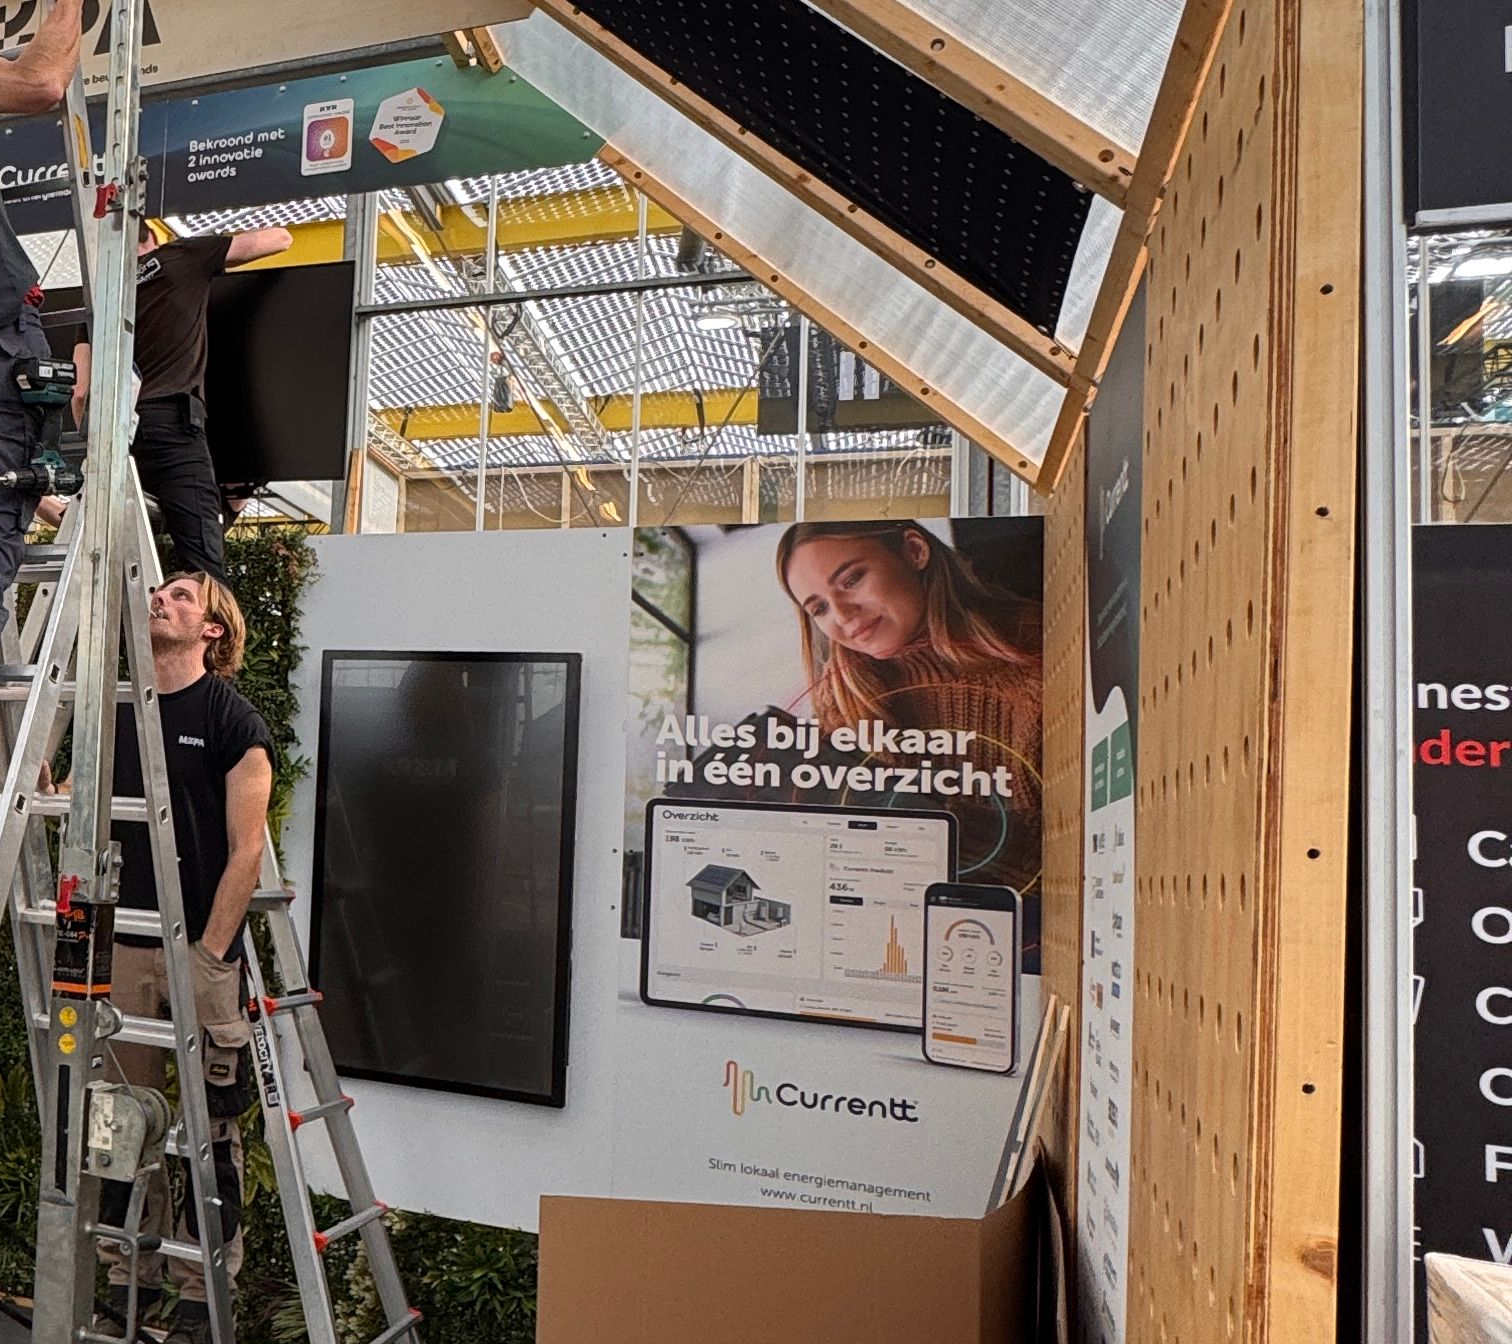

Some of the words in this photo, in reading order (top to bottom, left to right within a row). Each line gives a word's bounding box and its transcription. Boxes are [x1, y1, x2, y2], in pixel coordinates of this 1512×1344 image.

[189, 131, 254, 153] Bekroond
[257, 128, 286, 143] met
[188, 156, 197, 168] 2
[199, 147, 263, 166] innovatie
[187, 167, 237, 183] awards
[656, 713, 756, 749] Alles
[767, 717, 820, 759] bij
[830, 719, 977, 756] elkaar
[656, 751, 694, 784] in
[703, 753, 781, 788] één
[791, 761, 1013, 798] overzicht
[662, 809, 720, 822] Overzicht
[776, 1083, 919, 1122] Currentt
[708, 1157, 737, 1173] Slim
[740, 1163, 779, 1179] lokaal
[783, 1170, 931, 1202] energiemanagement
[760, 1186, 873, 1214] www.currentt.nl
